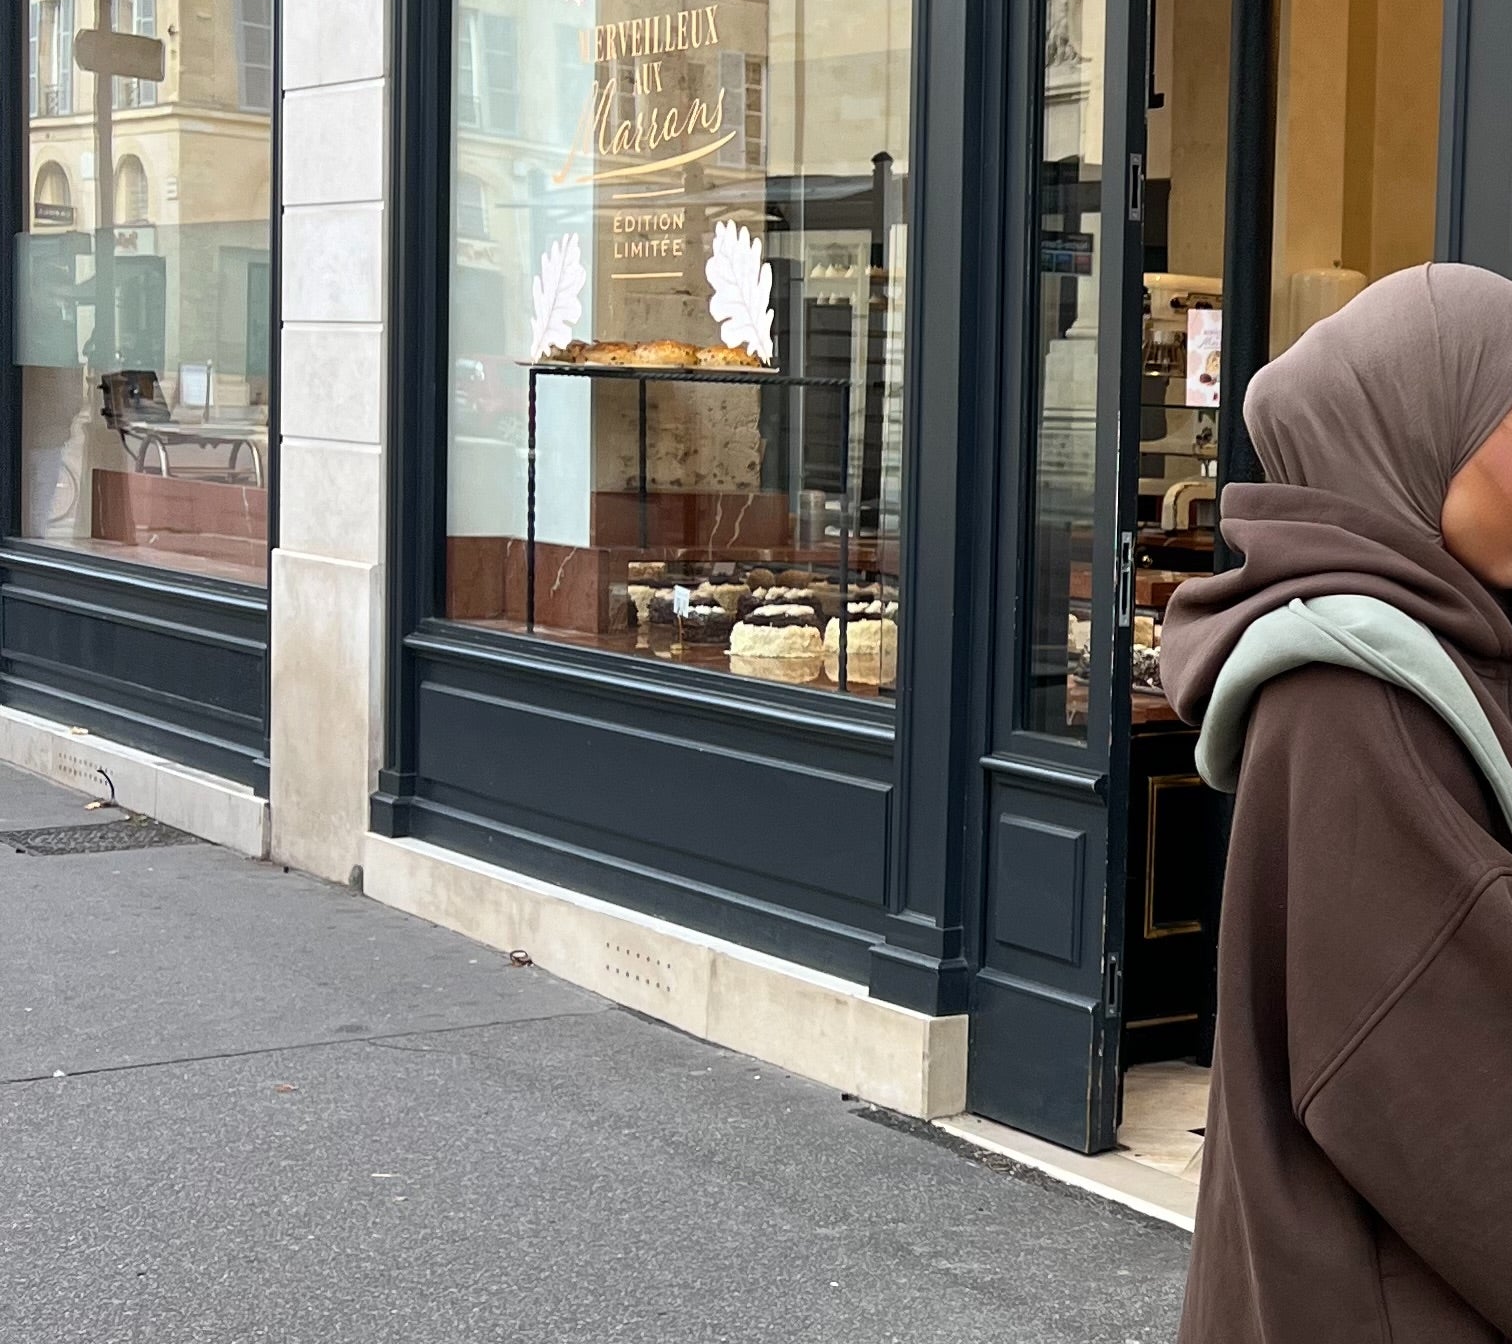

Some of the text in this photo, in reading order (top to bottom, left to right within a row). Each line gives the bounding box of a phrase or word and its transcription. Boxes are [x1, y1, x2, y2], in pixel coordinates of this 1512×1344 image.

[553, 78, 726, 184] Marrons
[613, 211, 684, 233] ÉDITION
[614, 234, 683, 258] LIMITÉE
